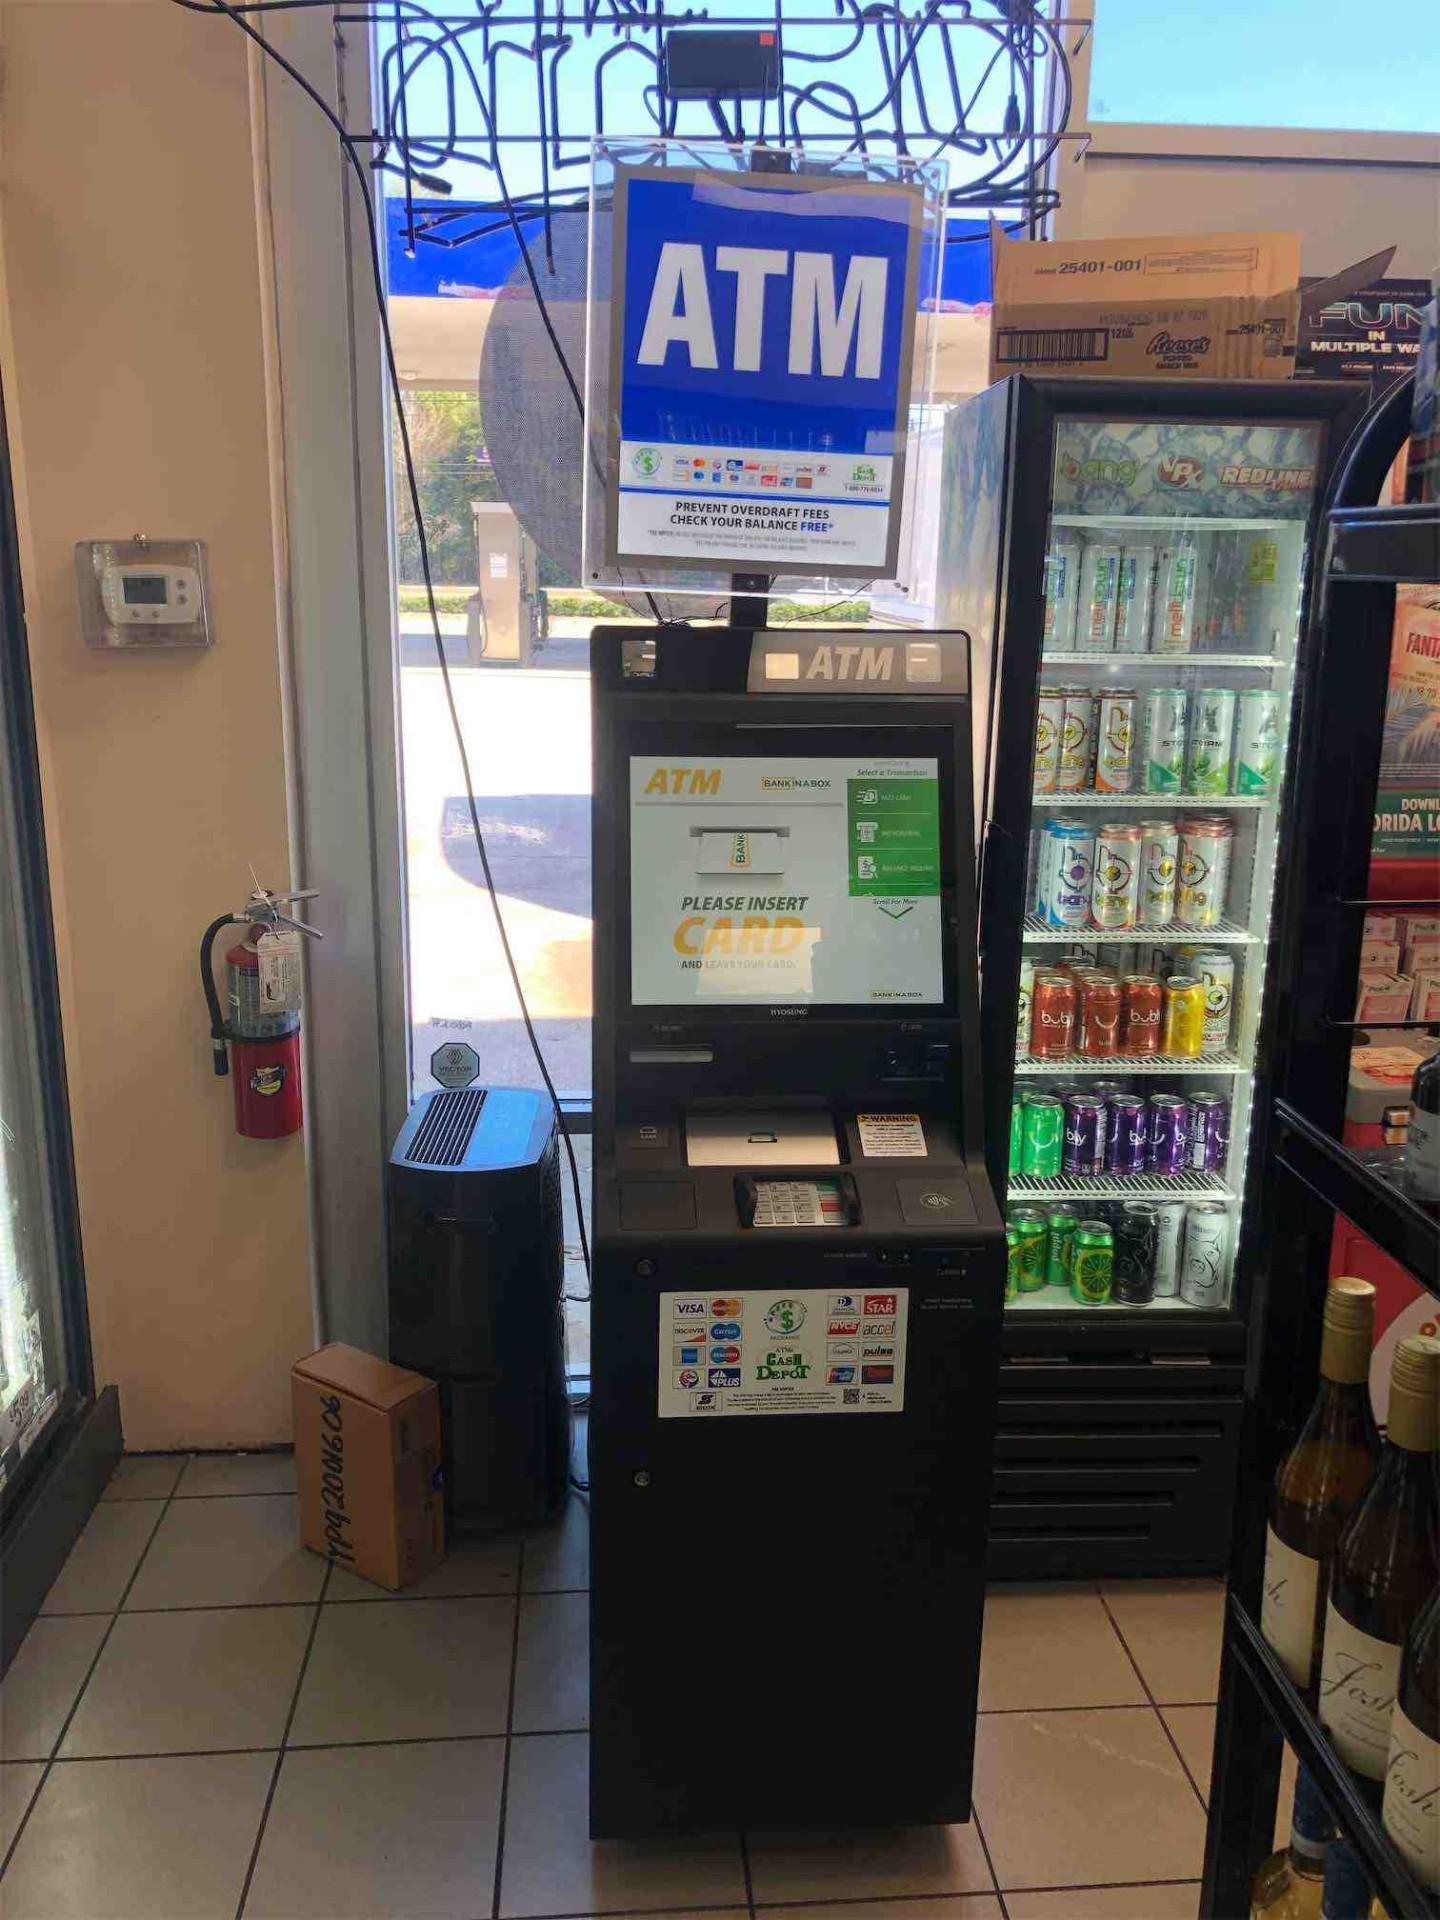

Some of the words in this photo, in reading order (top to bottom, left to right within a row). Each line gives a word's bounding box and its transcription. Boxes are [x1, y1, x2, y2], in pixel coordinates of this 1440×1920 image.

[1059, 259, 1141, 274] 25401-001
[637, 241, 889, 380] ATM
[1146, 330, 1211, 354] Reese's
[1368, 331, 1385, 341] IN
[1310, 341, 1392, 353] MULTIPLE
[1061, 451, 1137, 487] bang
[1220, 466, 1312, 487] REDLINE
[676, 501, 728, 514] PREVENT
[731, 504, 800, 518] OVERDRAFT
[803, 508, 830, 519] FEES
[670, 514, 708, 526] CHECK
[711, 516, 746, 528] YOUR
[745, 518, 798, 530] BALANCE
[806, 646, 894, 680] ATM
[857, 768, 878, 776] Select
[644, 768, 722, 795] ATM
[734, 831, 746, 863] BANK
[681, 897, 745, 911] PLEASE
[747, 897, 809, 911] INSERT
[672, 916, 805, 956] CARD
[681, 960, 702, 969] AND
[705, 960, 738, 969] LEAVE
[740, 960, 764, 969] YOUR
[770, 1008, 808, 1016] HYOSUNG
[677, 1304, 705, 1314] VISA
[867, 1303, 894, 1314] STAR
[831, 1320, 858, 1329] NYCE
[863, 1320, 896, 1335] accel
[719, 1377, 740, 1387] PLUS
[1320, 1651, 1398, 1715] Josh
